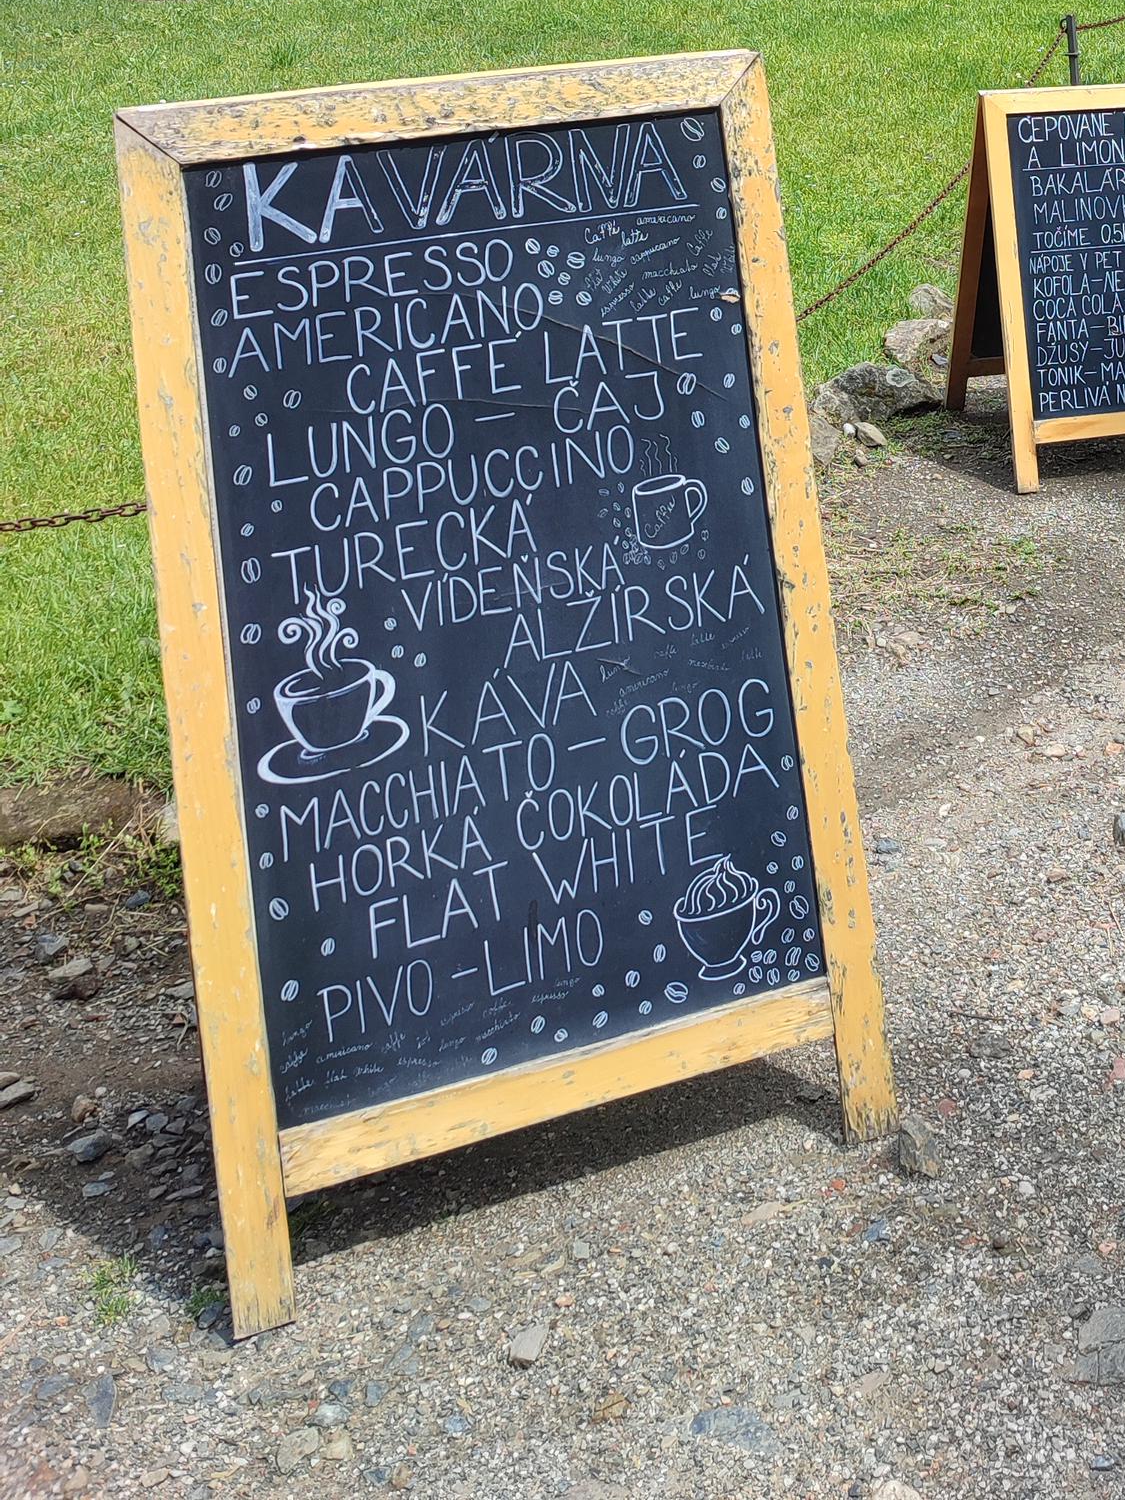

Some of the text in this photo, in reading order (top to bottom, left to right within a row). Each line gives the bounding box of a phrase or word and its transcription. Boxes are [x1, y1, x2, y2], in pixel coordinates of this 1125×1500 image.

[244, 121, 689, 252] KAVÁRNA
[1027, 146, 1041, 169] A
[230, 238, 514, 319] ESPRESSO
[1029, 253, 1074, 275] NÁPOJE
[1079, 253, 1088, 270] V
[1094, 250, 1122, 269] PET
[1032, 225, 1091, 249] TOČÍME
[228, 282, 544, 378] AMERICANO
[1033, 298, 1077, 321] COCA
[346, 307, 703, 414] CAFFÉ LATTE
[1038, 381, 1112, 412] PERLIVÁ
[267, 403, 454, 487] LUNGO
[552, 372, 667, 434] ČAJ
[310, 425, 634, 532] CAPPUCCINO
[271, 494, 537, 604] TURECKÁ
[401, 536, 625, 631] VÍDEŇSKÁ
[504, 554, 765, 668] ALŽÍRSKÁ
[420, 661, 598, 757] KÁVA
[280, 733, 555, 861] MACCHIATO
[620, 678, 774, 765] GROG
[309, 744, 780, 912] HORKÁ ČOKOLÁDA
[368, 804, 723, 959] FLAT WHITE
[317, 959, 434, 1043] PIVO
